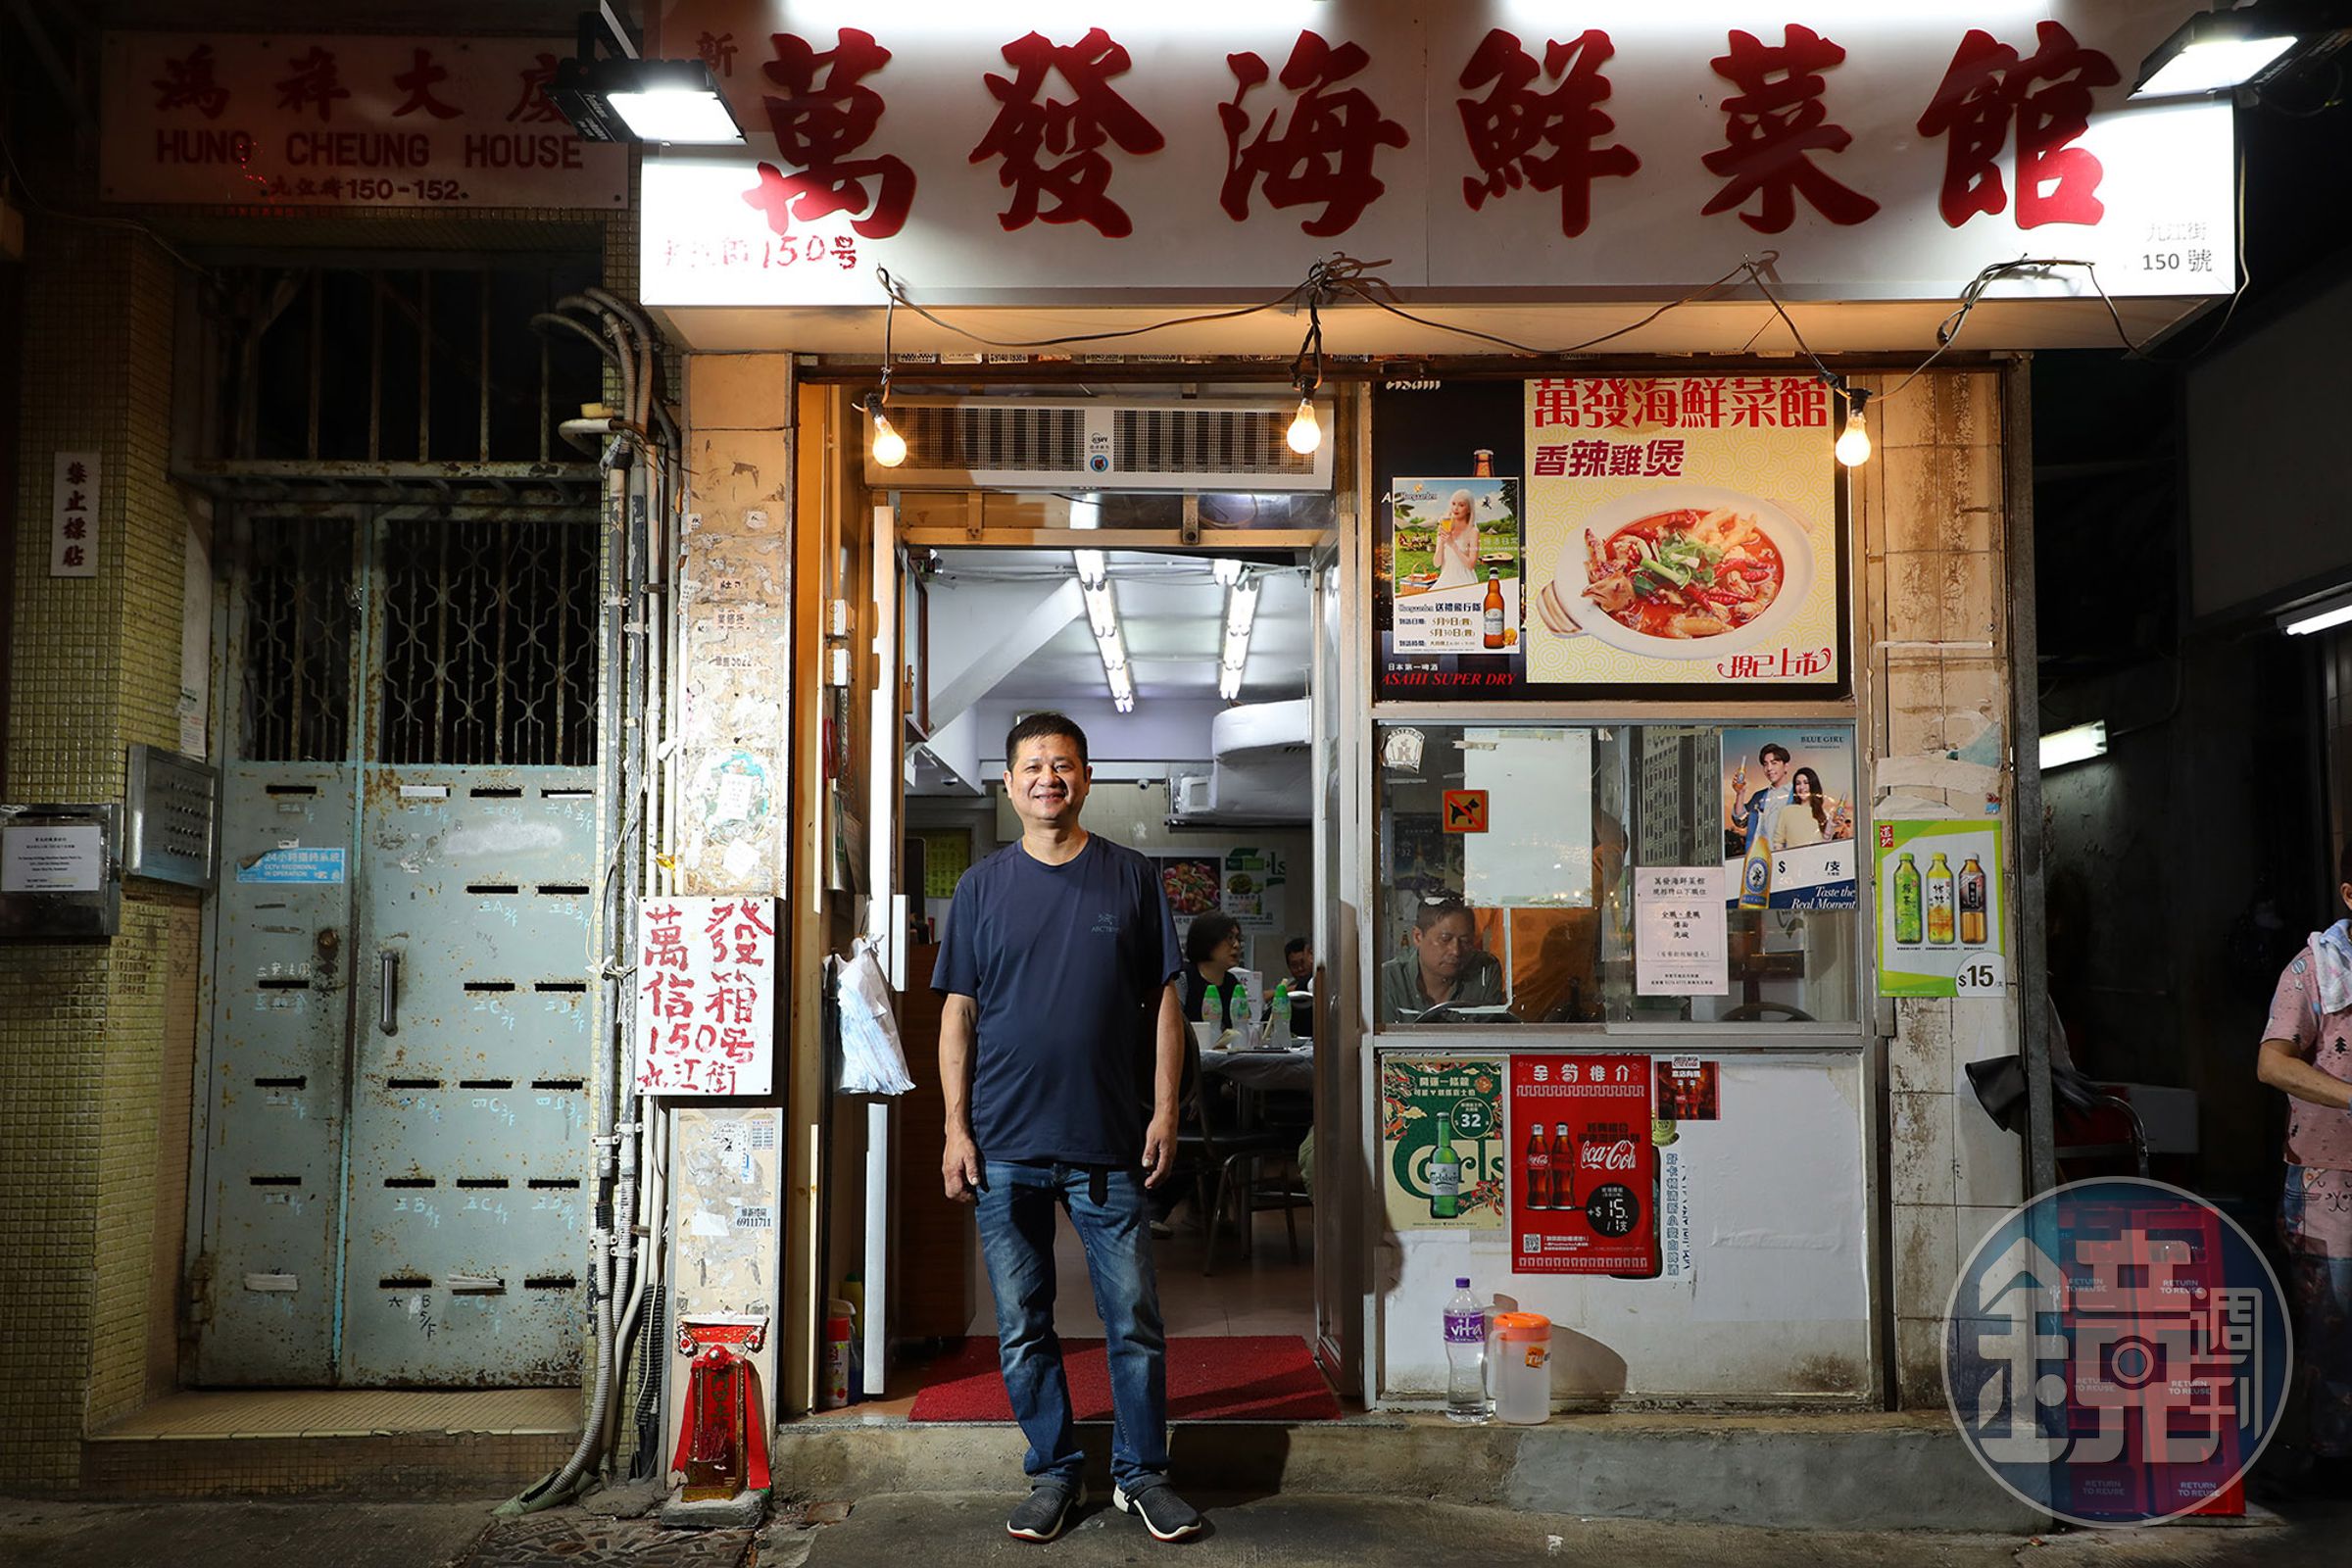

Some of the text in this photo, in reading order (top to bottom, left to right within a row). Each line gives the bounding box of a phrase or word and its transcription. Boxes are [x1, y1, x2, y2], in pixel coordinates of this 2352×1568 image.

[696, 30, 738, 78] 新
[742, 22, 2121, 239] 萬發海鮮菜館
[157, 129, 584, 169] HUNG CHEUNG HOUSE
[2142, 253, 2180, 270] 150
[1534, 377, 1828, 429] 萬發海鮮菜館
[1534, 440, 1685, 478] 香辣雞煲
[1716, 647, 1832, 679] 現已上市
[1382, 673, 1518, 685] ASAHI SUPER DRY
[1815, 885, 1856, 897] Taste the
[1791, 897, 1856, 908] Real Moment
[1534, 1063, 1630, 1084] 至筍推介
[1461, 1113, 1481, 1128] 32
[2162, 1279, 2199, 1288] RETURN
[1450, 1316, 1483, 1337] vita
